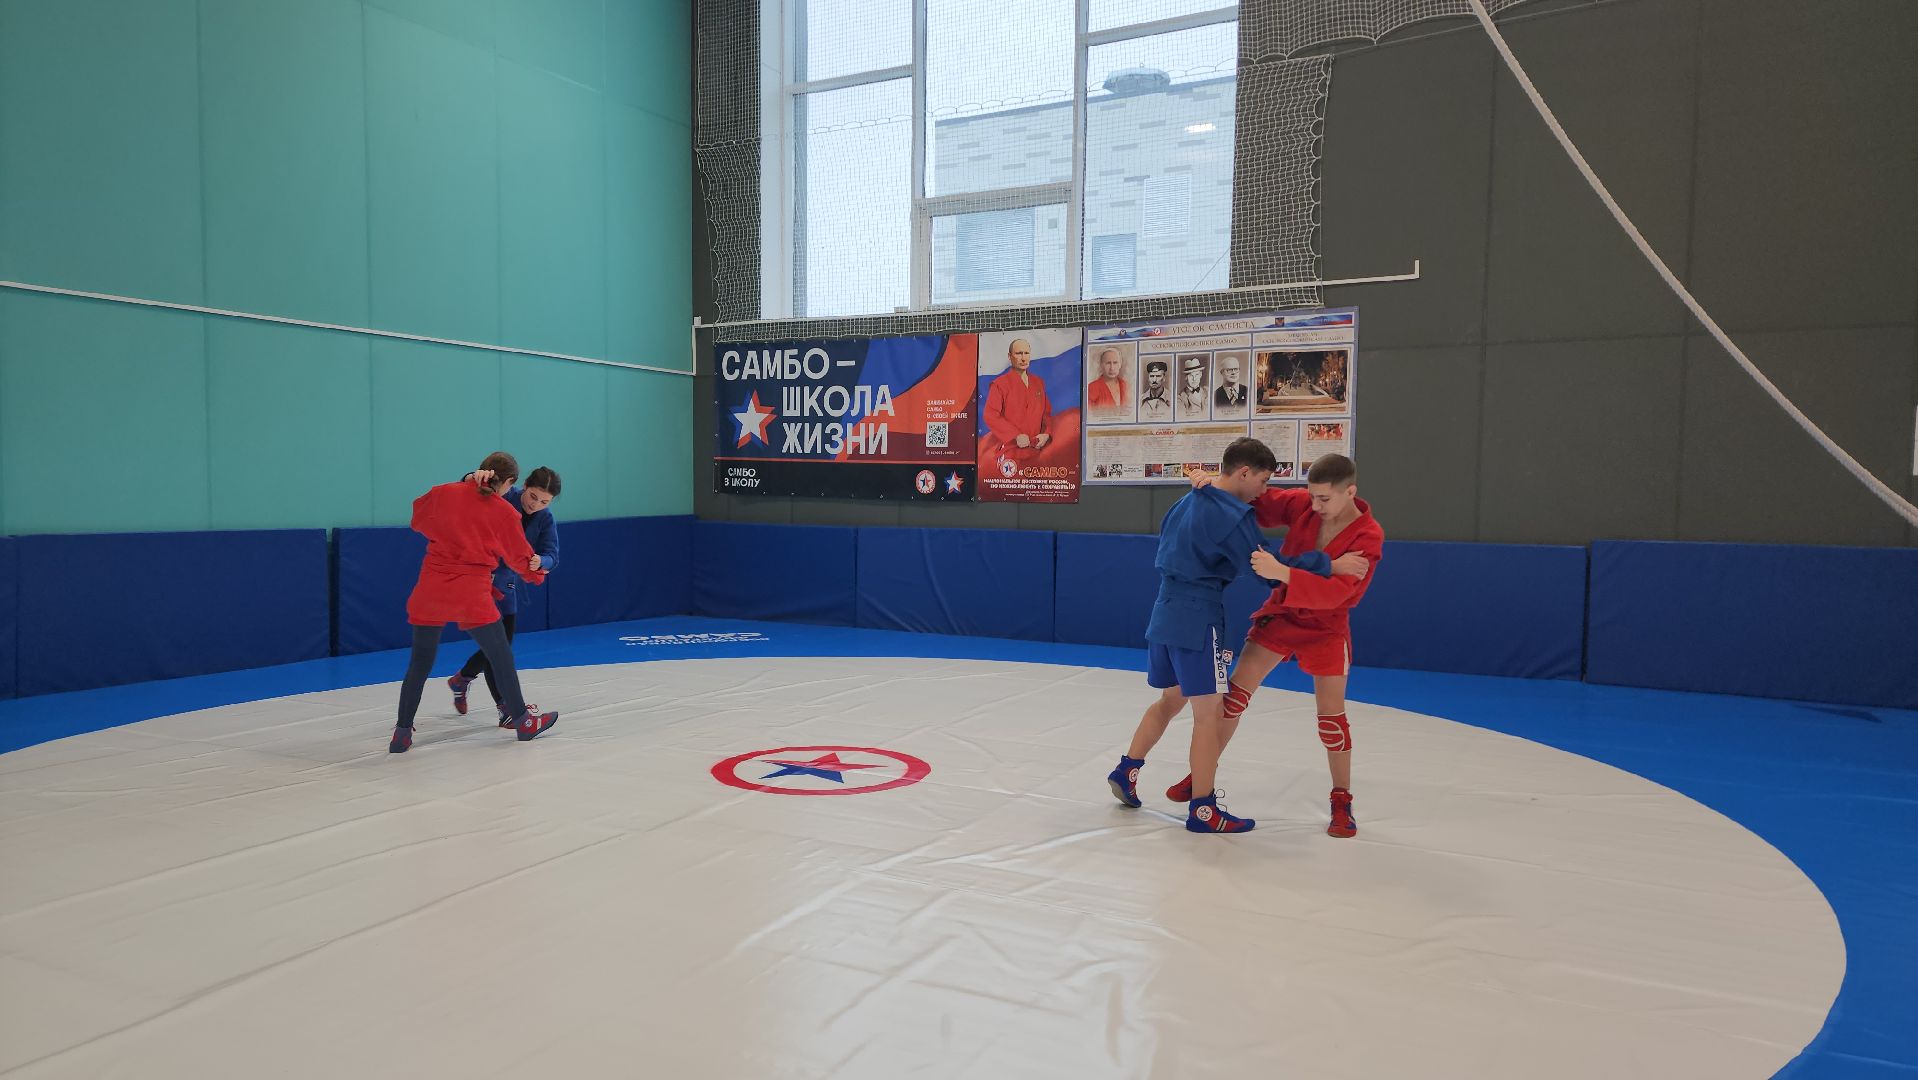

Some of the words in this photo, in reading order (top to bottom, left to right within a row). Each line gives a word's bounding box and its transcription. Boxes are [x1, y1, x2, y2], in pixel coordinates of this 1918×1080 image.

[722, 348, 830, 381] САМБО
[782, 384, 895, 418] ШКОЛА
[782, 422, 888, 455] ЖИЗНИ
[727, 467, 757, 478] САМБО
[731, 477, 761, 488] ШКОЛУ
